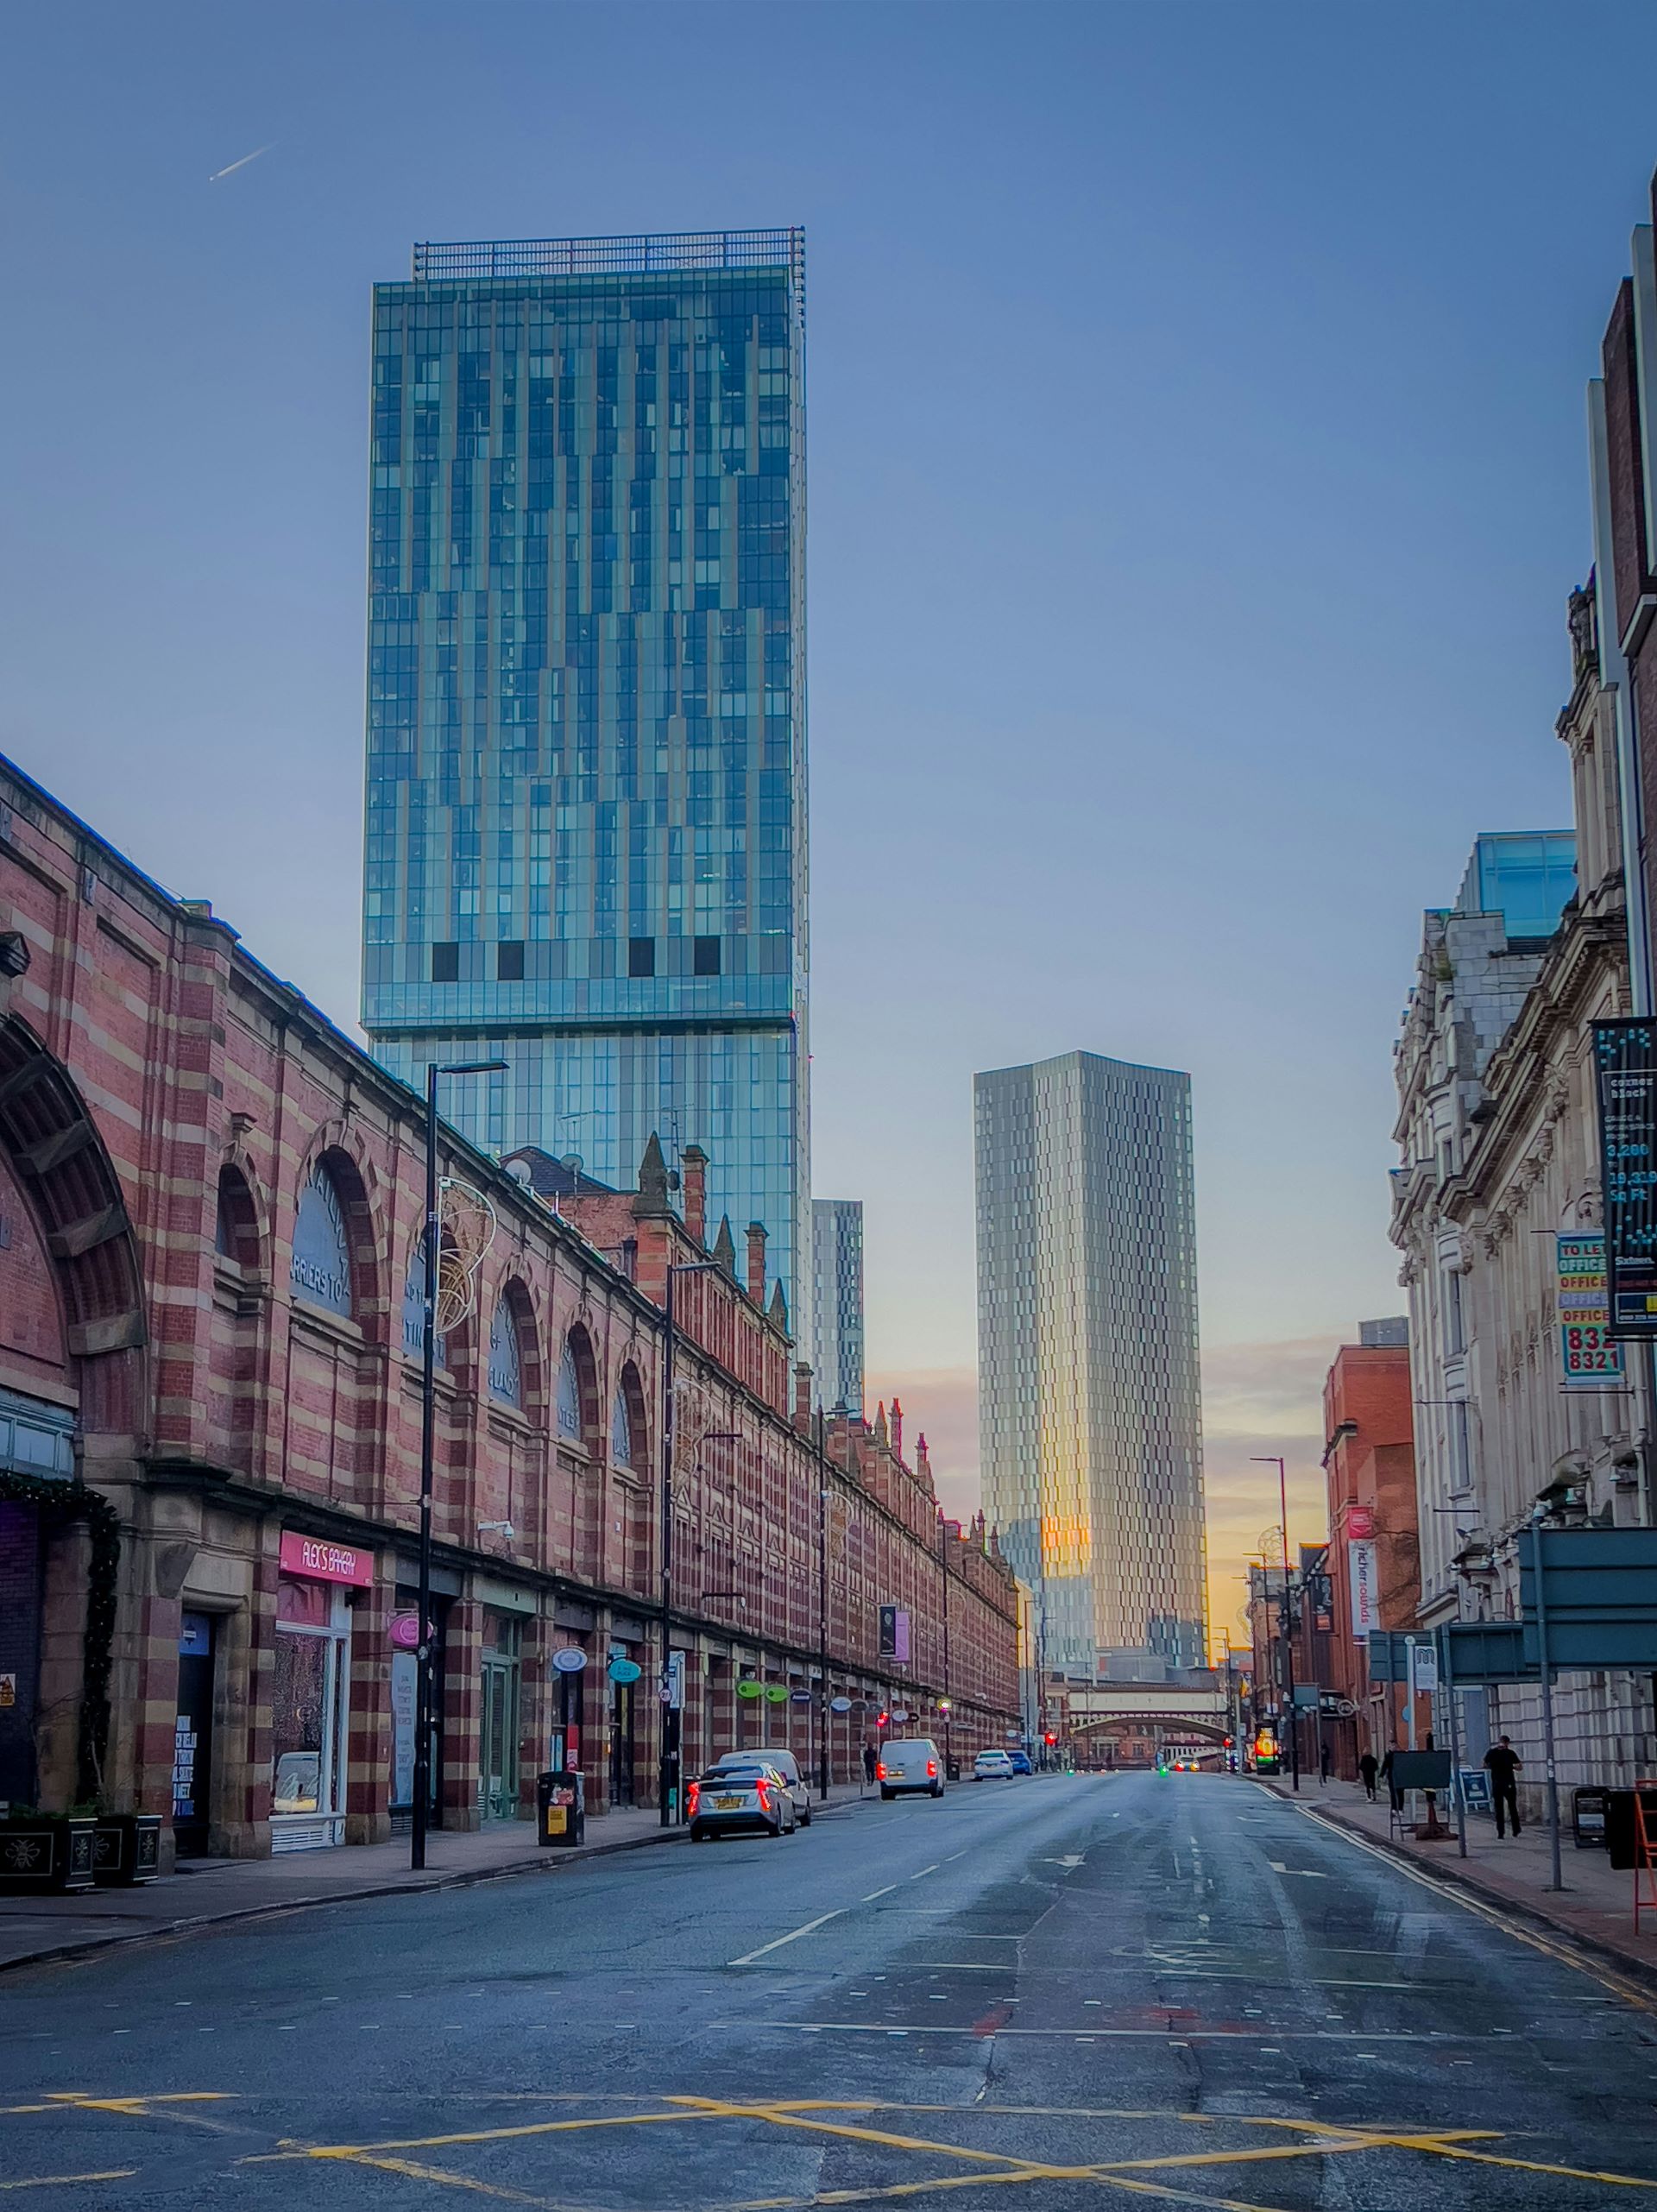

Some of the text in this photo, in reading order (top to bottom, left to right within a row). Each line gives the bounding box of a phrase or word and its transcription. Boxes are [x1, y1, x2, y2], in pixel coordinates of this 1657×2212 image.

[1610, 1078, 1654, 1087] corner
[1611, 1088, 1647, 1099] block
[1610, 1188, 1648, 1202] Sq Ft
[1561, 1245, 1580, 1256] TO
[1559, 1258, 1607, 1272] OFFICE
[1561, 1276, 1608, 1288] OFFICE
[1564, 1310, 1610, 1321] OFFICE
[1570, 1352, 1618, 1370] 8321
